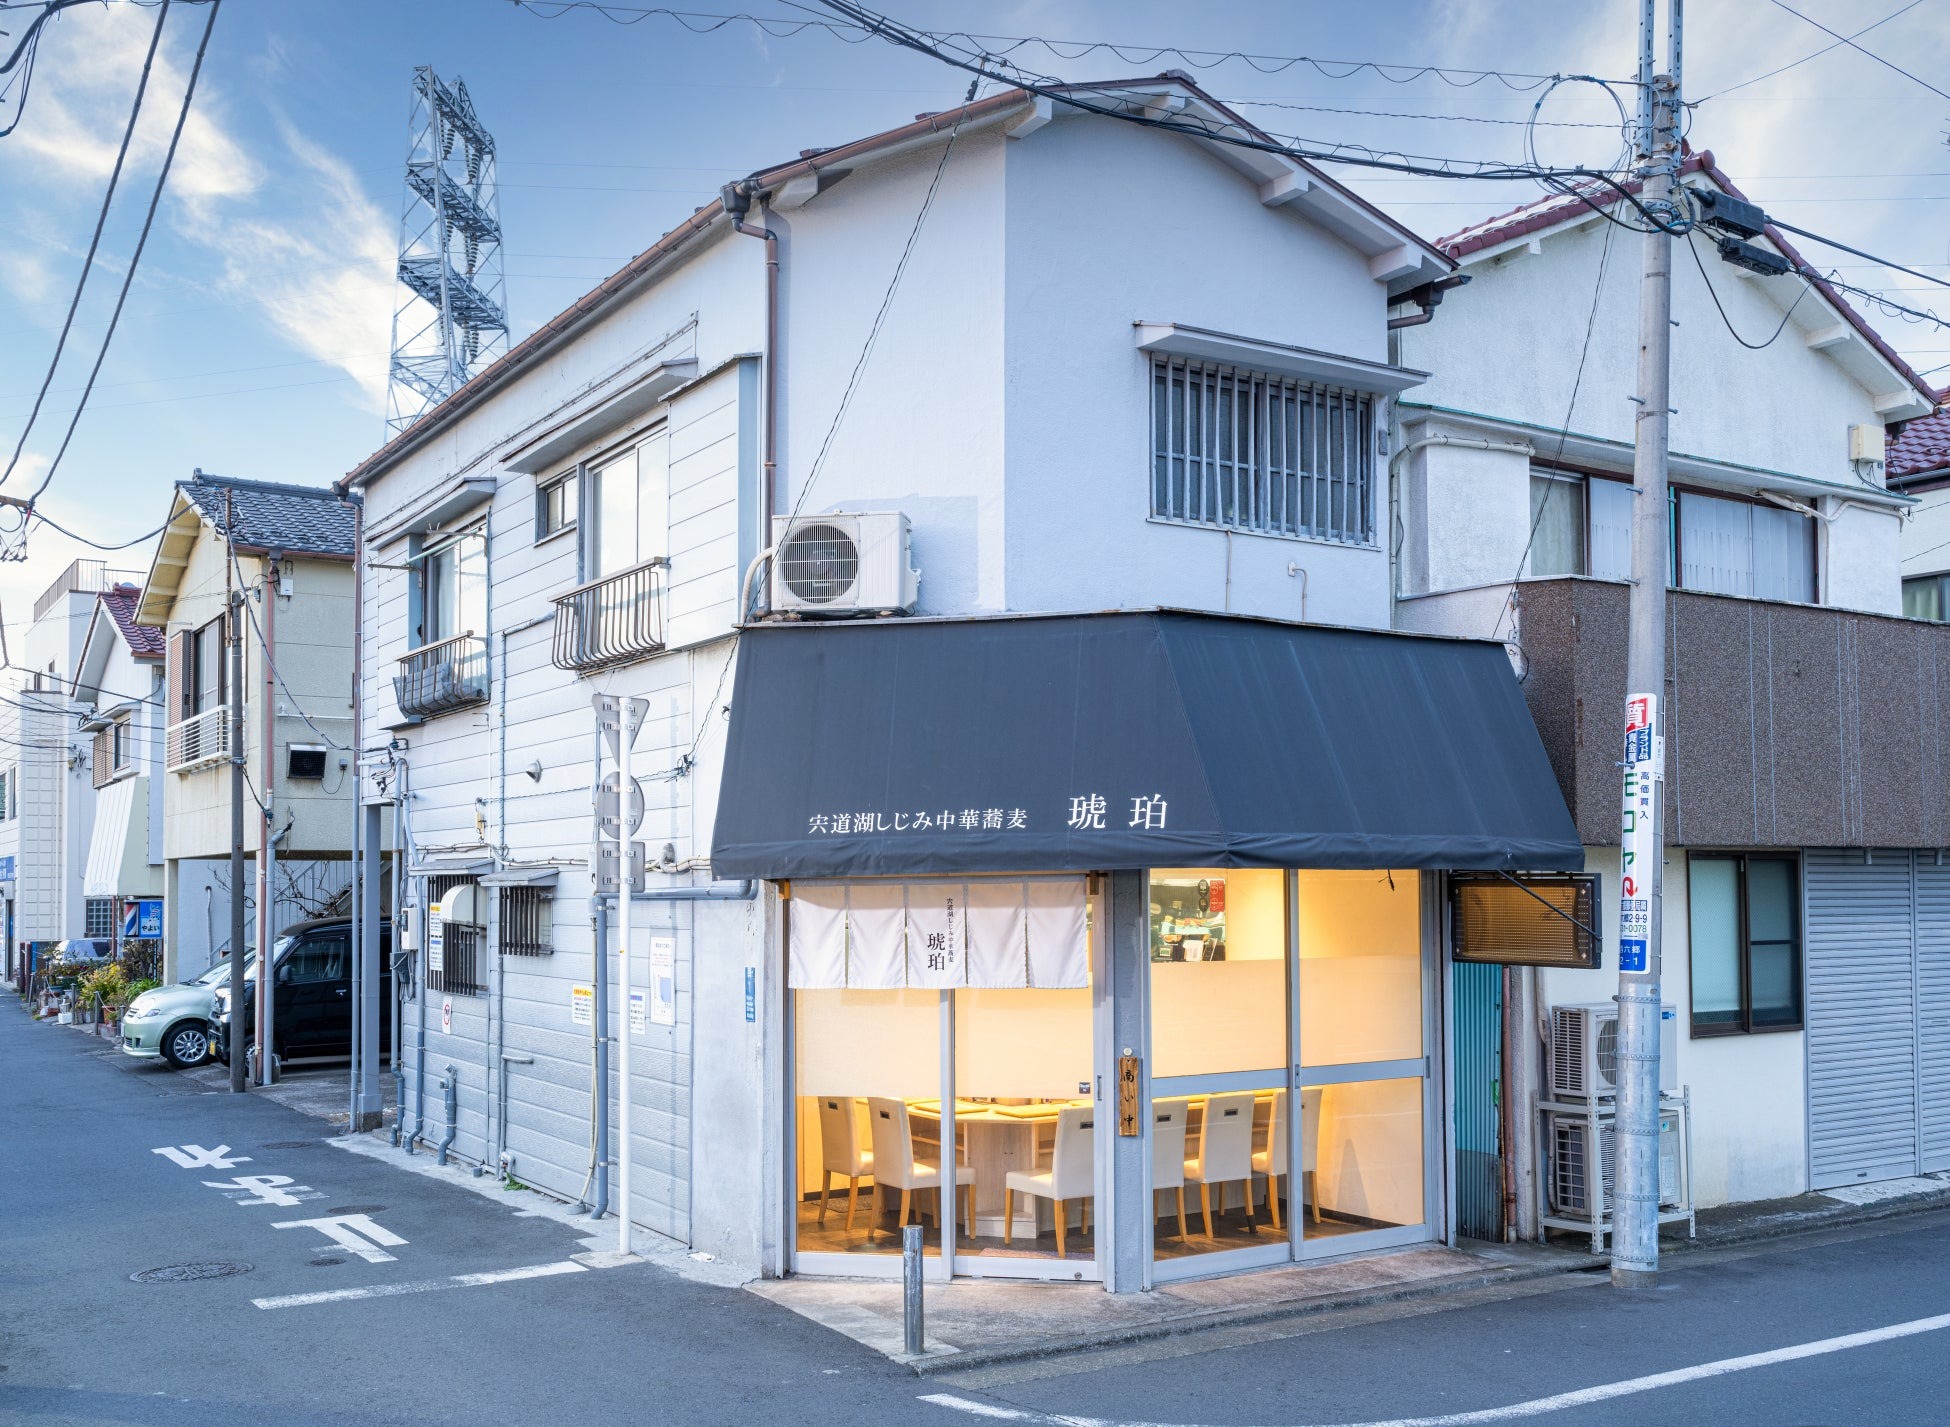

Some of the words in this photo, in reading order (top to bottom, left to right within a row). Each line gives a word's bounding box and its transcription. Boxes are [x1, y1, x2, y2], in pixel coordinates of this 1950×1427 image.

[1067, 793, 1168, 831] 琥珀
[1639, 771, 1650, 820] 高価買入
[808, 807, 1028, 834] 宍道湖しじみ中華蕎麦
[141, 924, 160, 932] やよい
[946, 897, 955, 964] 宍道湖しじみ中華蕎麦
[926, 932, 946, 972] 琥珀
